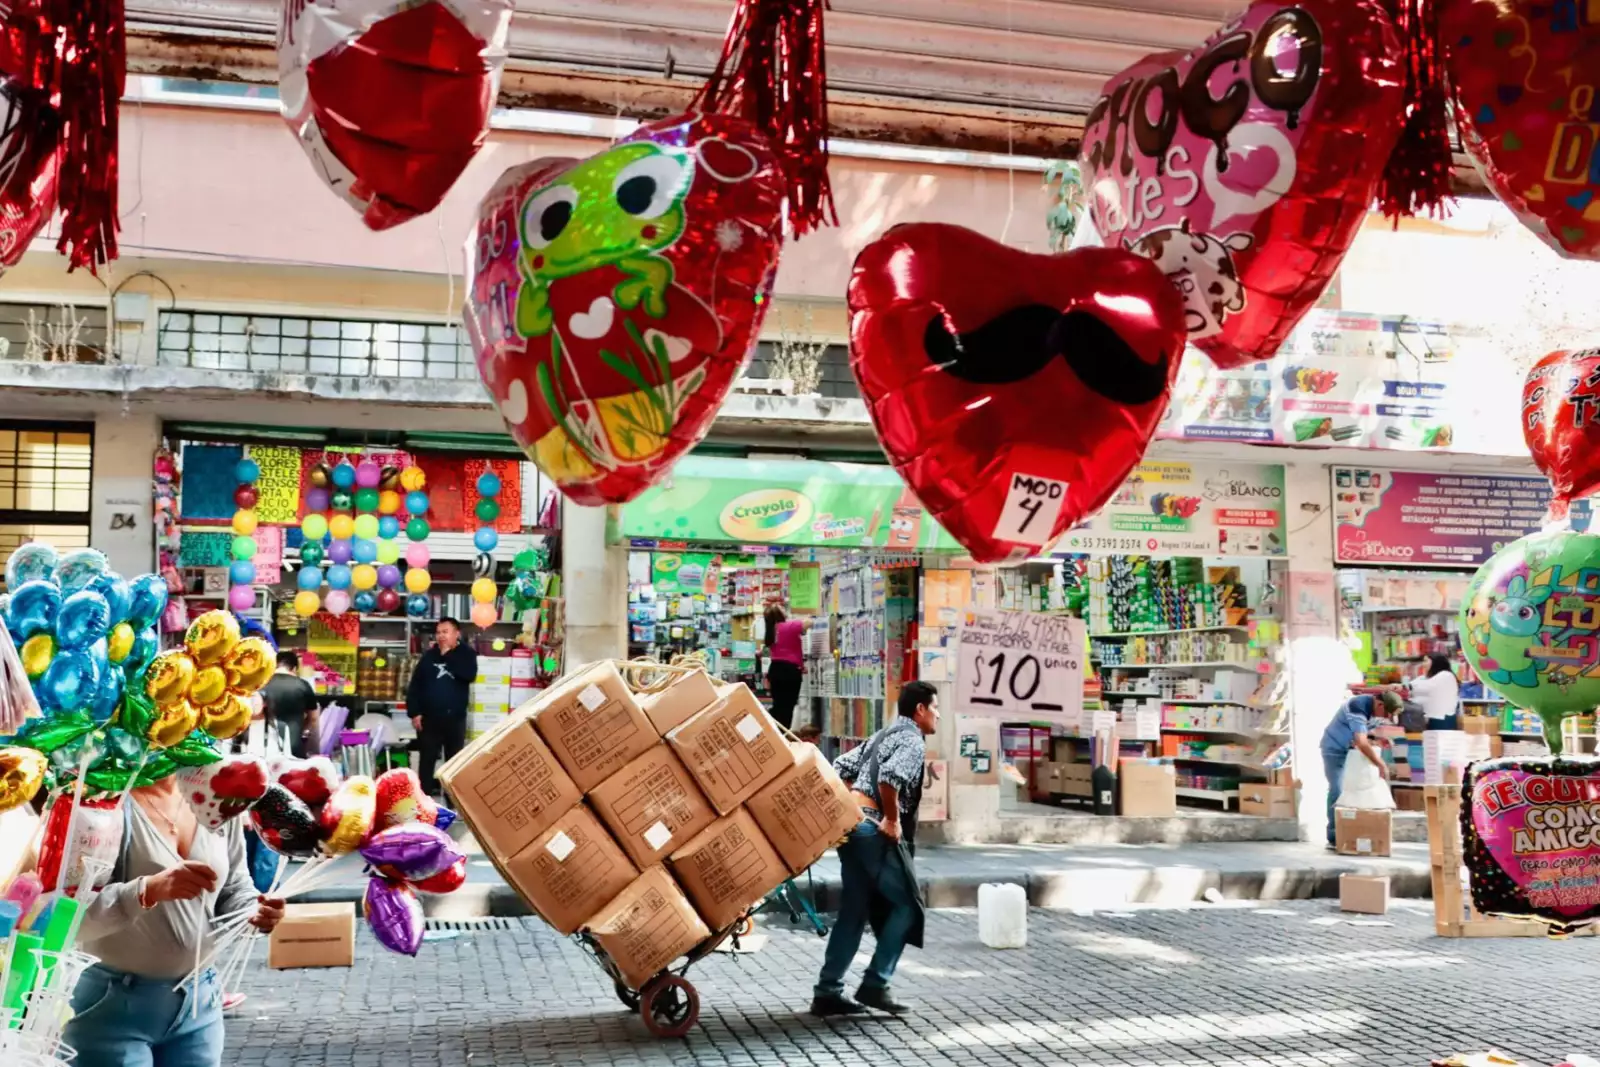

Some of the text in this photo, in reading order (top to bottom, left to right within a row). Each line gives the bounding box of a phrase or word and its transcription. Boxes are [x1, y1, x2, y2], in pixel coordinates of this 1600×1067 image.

[255, 457, 297, 468] OLORES
[1013, 475, 1063, 499] MOD
[1231, 485, 1281, 498] BLANCO
[734, 499, 795, 518] Crayola
[1018, 497, 1043, 533] 4
[1082, 536, 1141, 550] 55 7392 2574
[1367, 544, 1414, 557] BLANCO
[972, 649, 1041, 701] $10
[1479, 778, 1524, 816] TE
[1521, 859, 1549, 872] PERO
[1552, 856, 1586, 869] COMO
